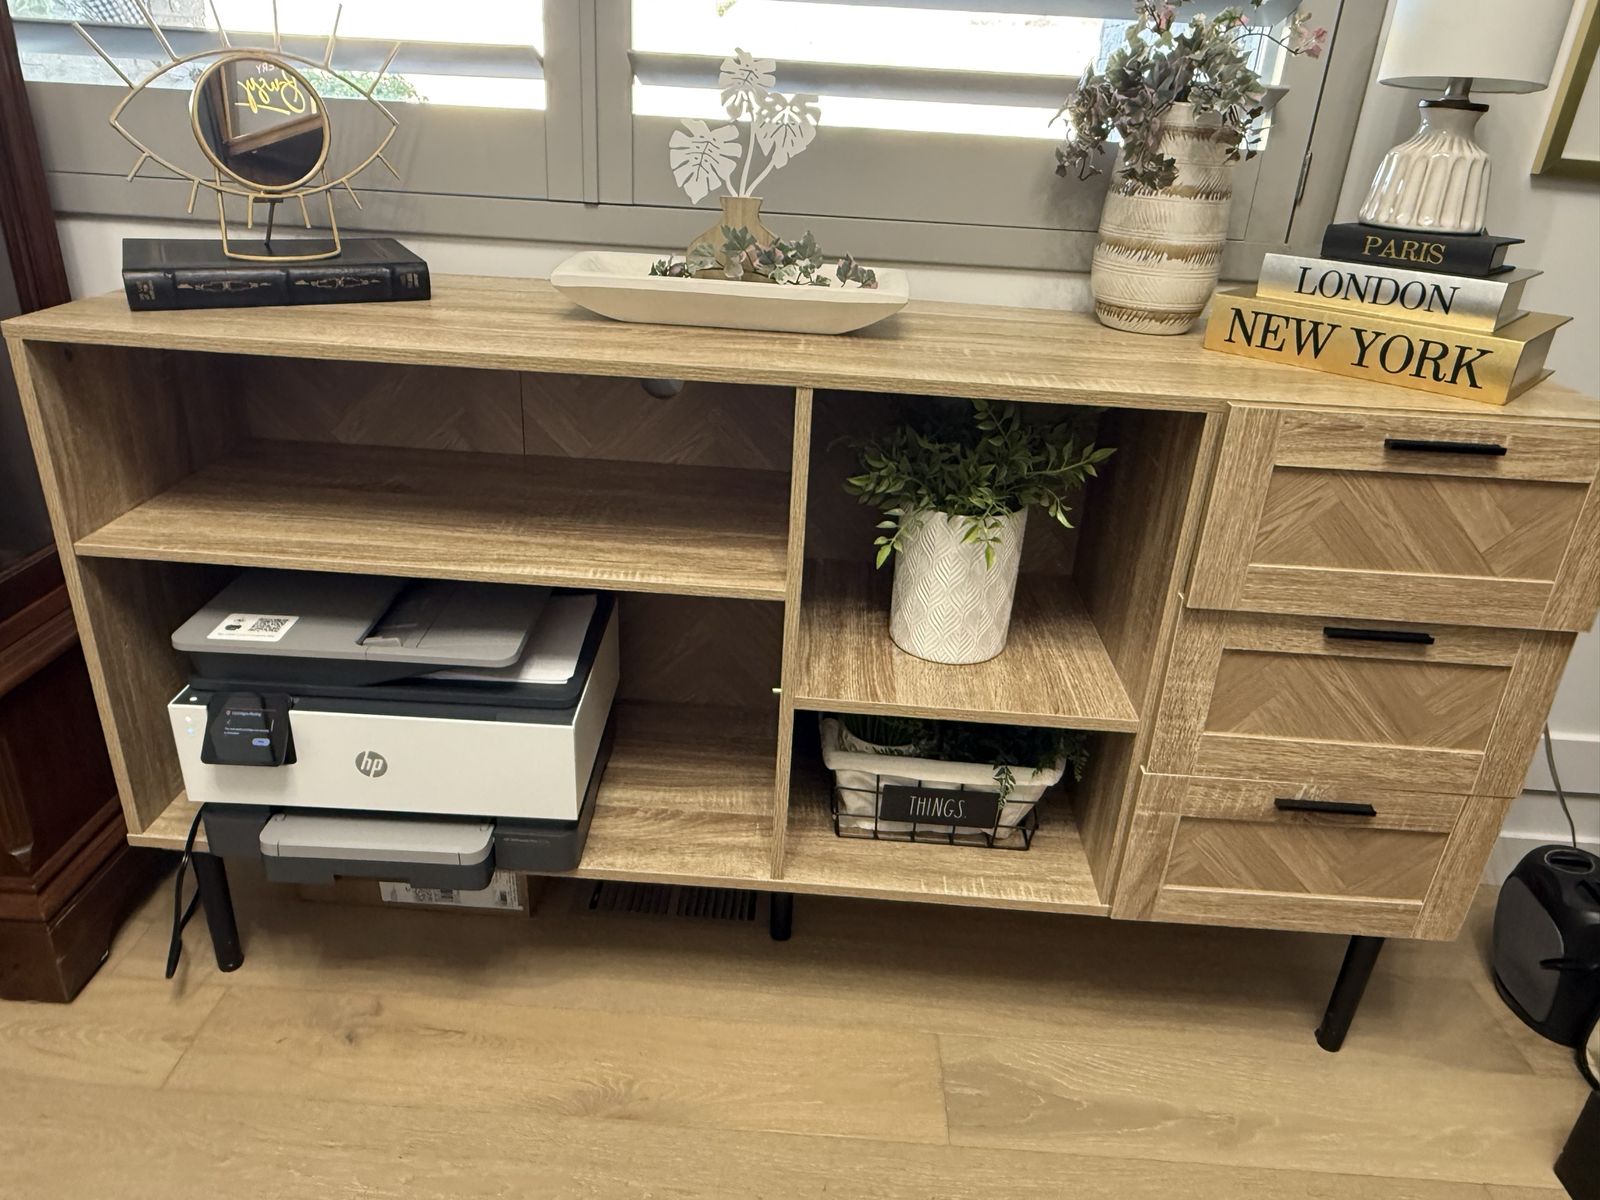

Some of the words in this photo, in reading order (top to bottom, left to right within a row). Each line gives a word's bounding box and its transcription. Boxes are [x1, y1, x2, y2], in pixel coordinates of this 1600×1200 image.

[1362, 235, 1447, 265] PARIS
[1294, 266, 1460, 315] LONDON
[1223, 307, 1342, 360] NEW
[1350, 327, 1494, 390] YORK
[359, 751, 385, 778] hp
[909, 795, 967, 819] THINGS.
